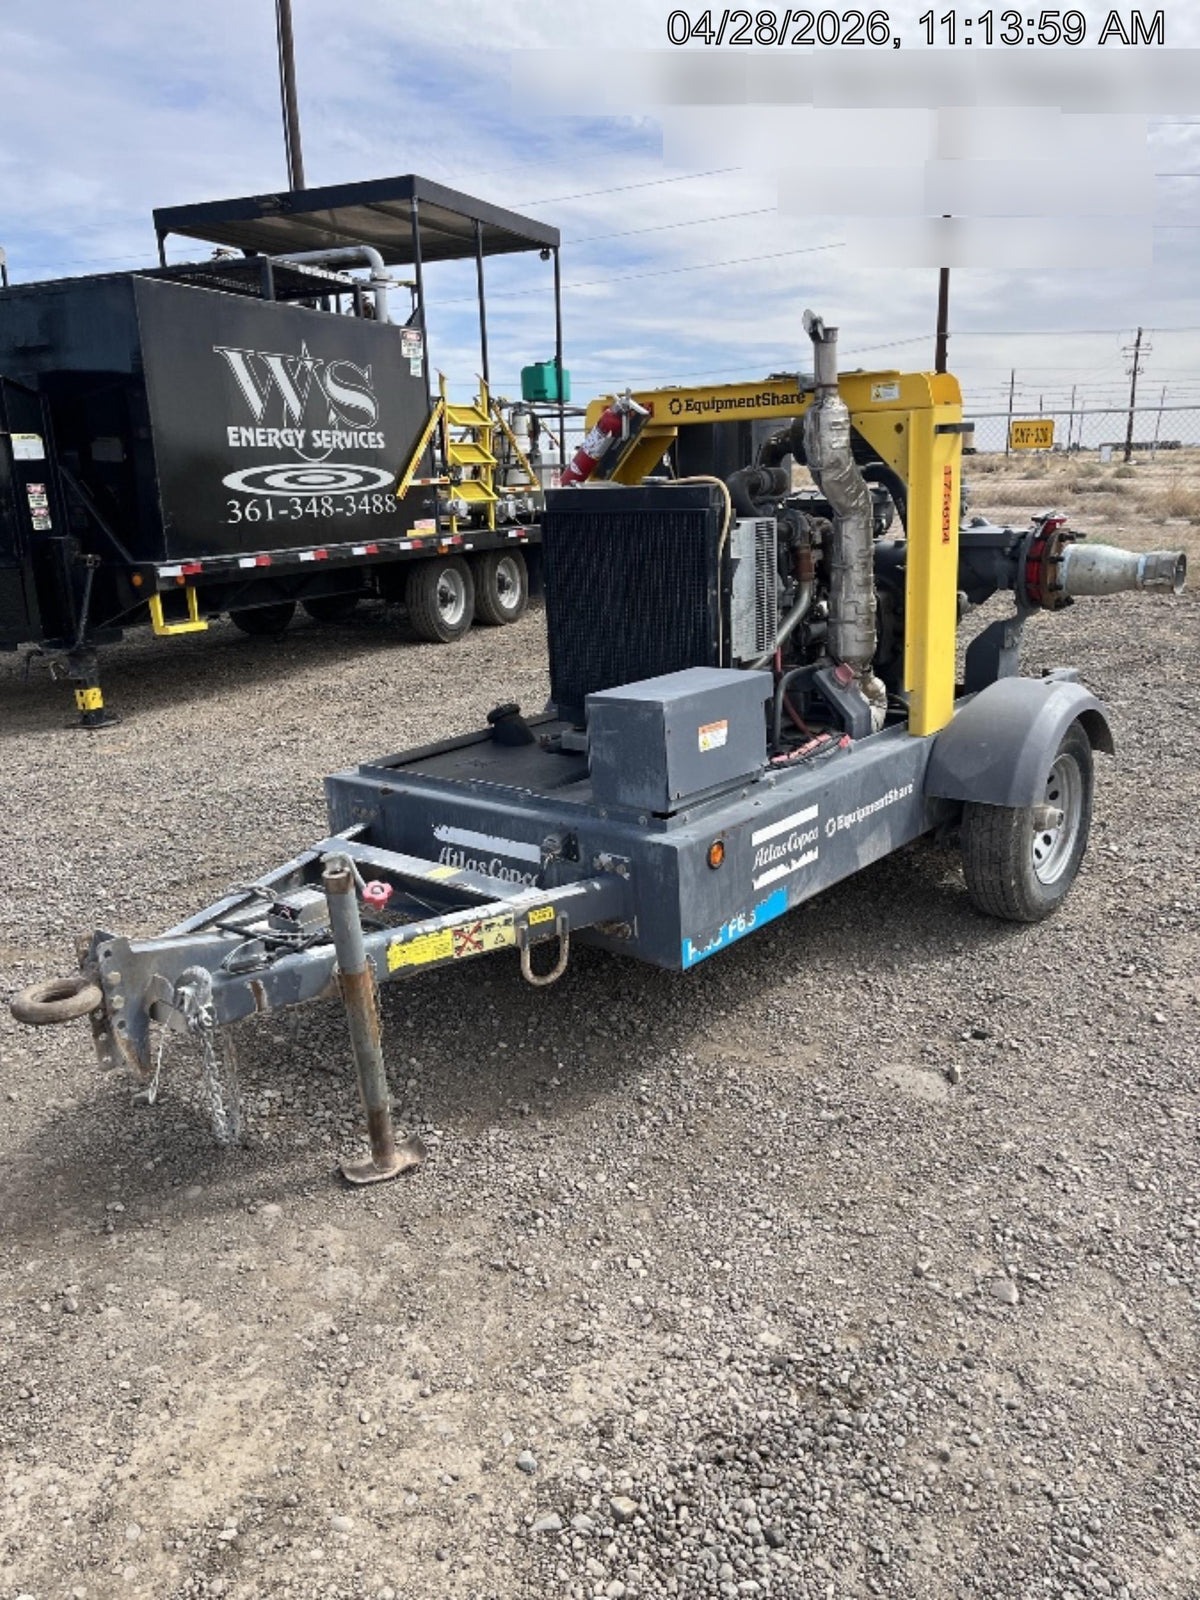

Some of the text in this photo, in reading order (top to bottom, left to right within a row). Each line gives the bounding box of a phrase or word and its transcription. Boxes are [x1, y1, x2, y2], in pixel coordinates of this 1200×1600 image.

[685, 392, 806, 415] EquipmentShare
[227, 426, 385, 450] ENERGY SERVICES
[227, 494, 397, 523] 361-348-3488
[836, 783, 914, 831] EquipmentShare
[438, 846, 487, 875] Atlas
[752, 844, 787, 872] Atlas
